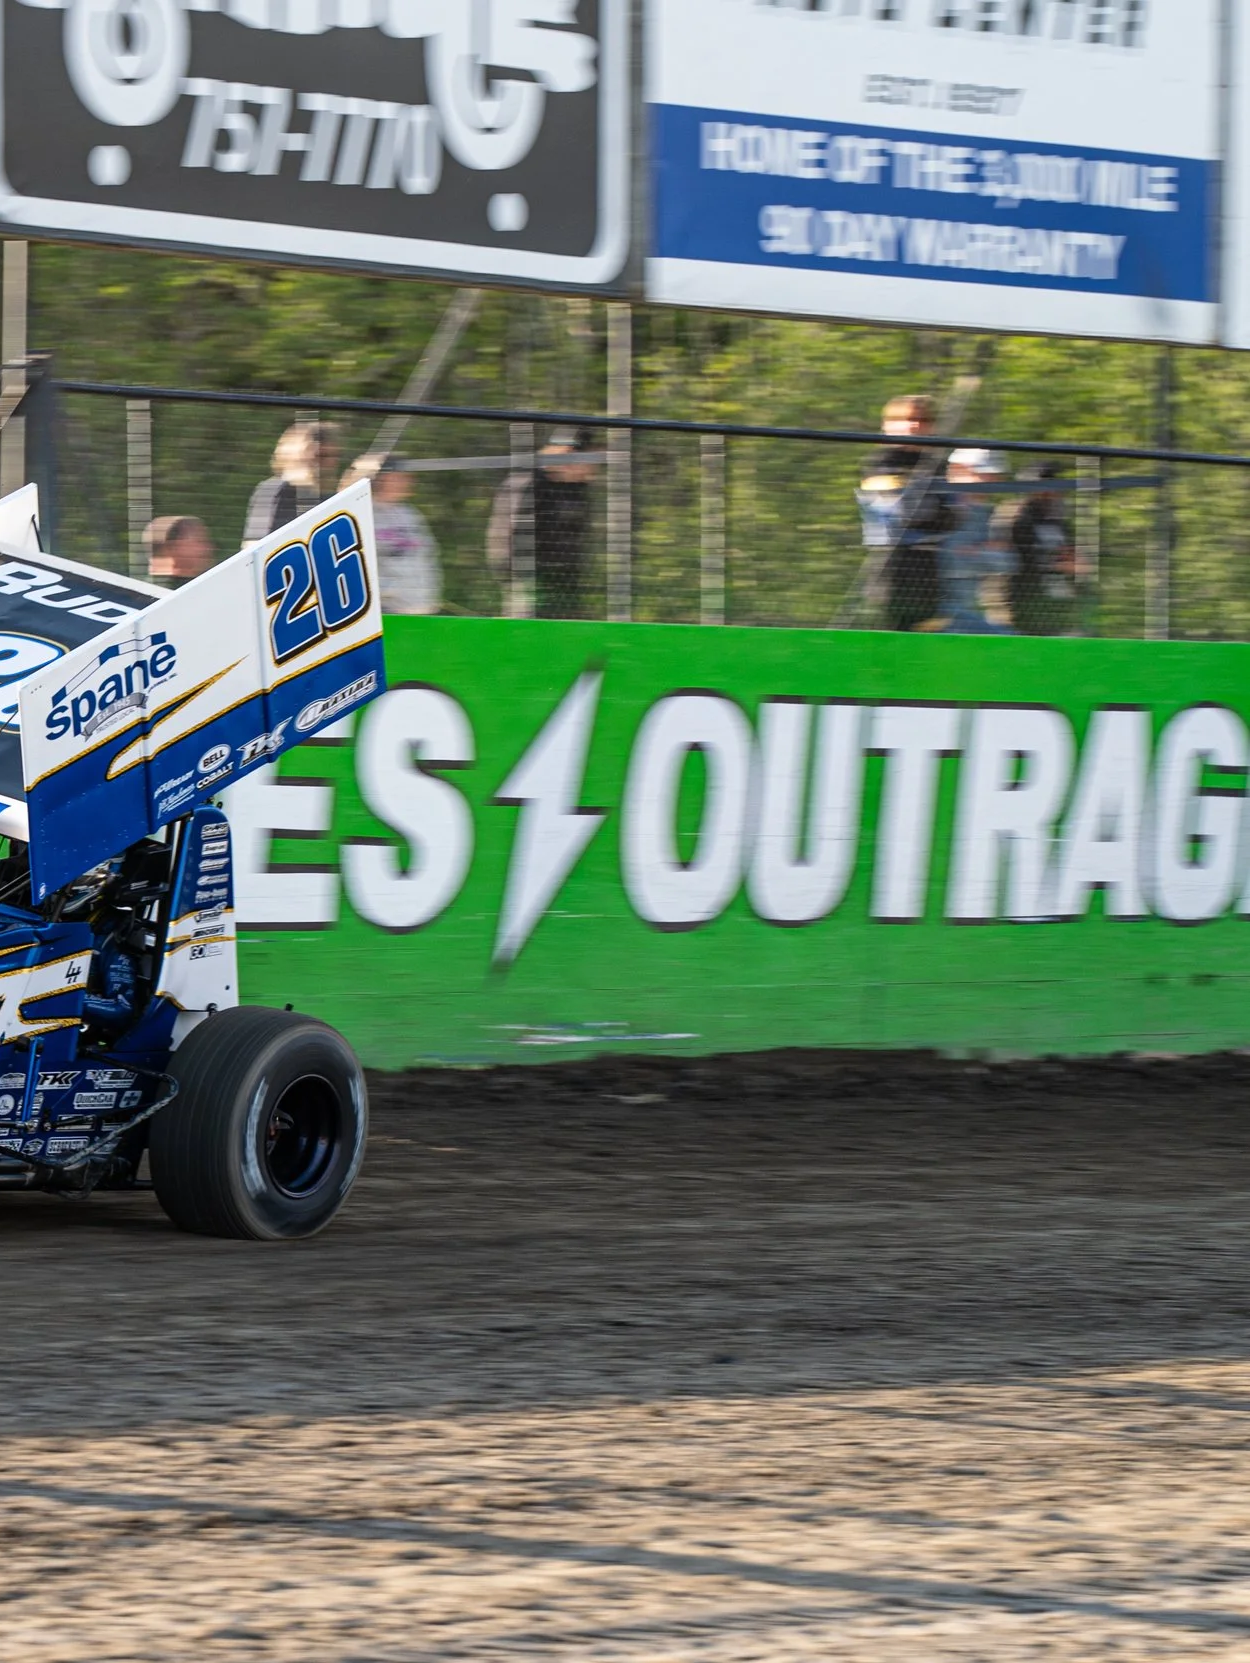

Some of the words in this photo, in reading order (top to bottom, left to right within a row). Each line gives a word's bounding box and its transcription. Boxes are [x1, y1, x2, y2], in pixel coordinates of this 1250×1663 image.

[700, 121, 828, 179] HOME
[825, 134, 889, 185] OF
[888, 141, 976, 193] THE
[1081, 159, 1179, 212] MILE
[759, 204, 820, 254] 90
[822, 209, 907, 261] DAY
[902, 216, 1127, 280] WARRANTY
[265, 510, 371, 666] 26
[45, 643, 177, 740] spane
[319, 673, 375, 714] MAXIMA
[197, 762, 233, 789] COBALT
[203, 749, 225, 768] BELL
[620, 687, 1250, 932] OUTRAG
